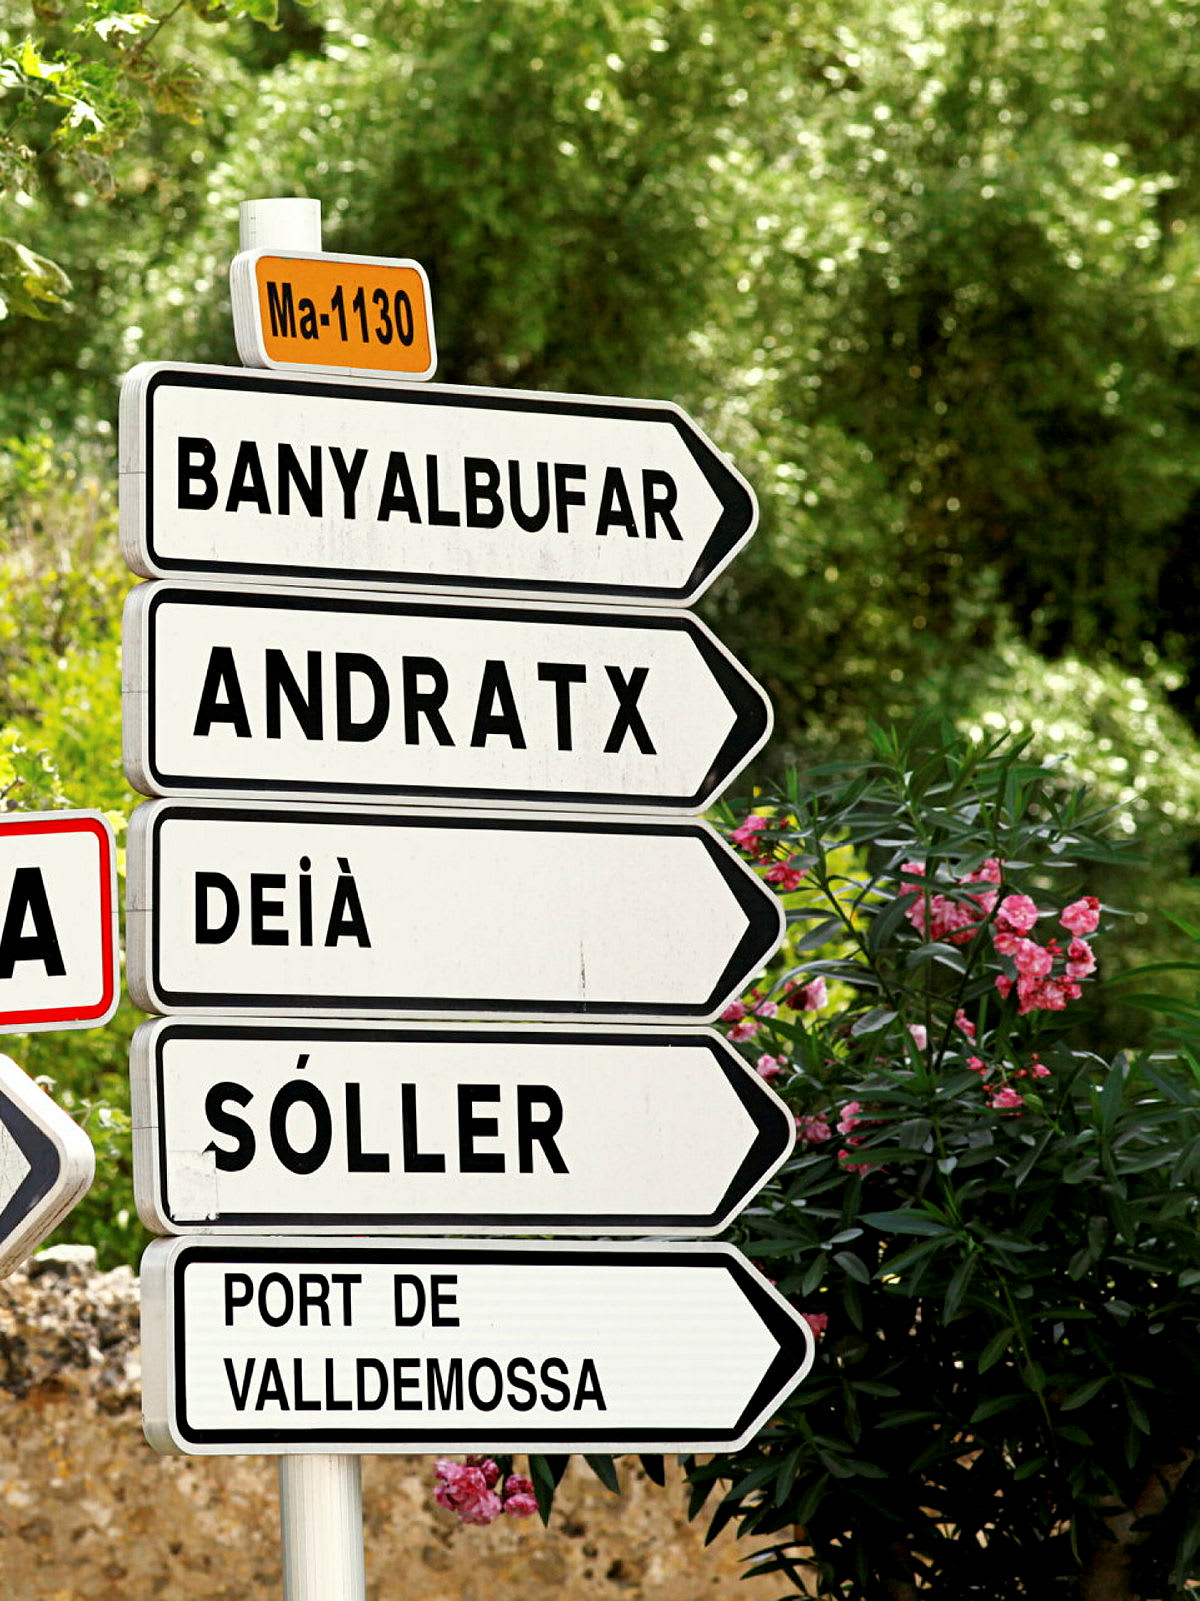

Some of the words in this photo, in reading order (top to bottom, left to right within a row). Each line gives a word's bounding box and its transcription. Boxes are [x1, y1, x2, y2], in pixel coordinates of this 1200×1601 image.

[266, 281, 414, 347] Ma-1130
[177, 436, 684, 541] BANYALBUFAR
[193, 646, 657, 756] ANDRATX
[203, 1053, 570, 1175] SÓLLER
[224, 1271, 362, 1328] PORT
[393, 1274, 460, 1328] DE
[223, 1356, 607, 1412] VALLDEMOSSA
